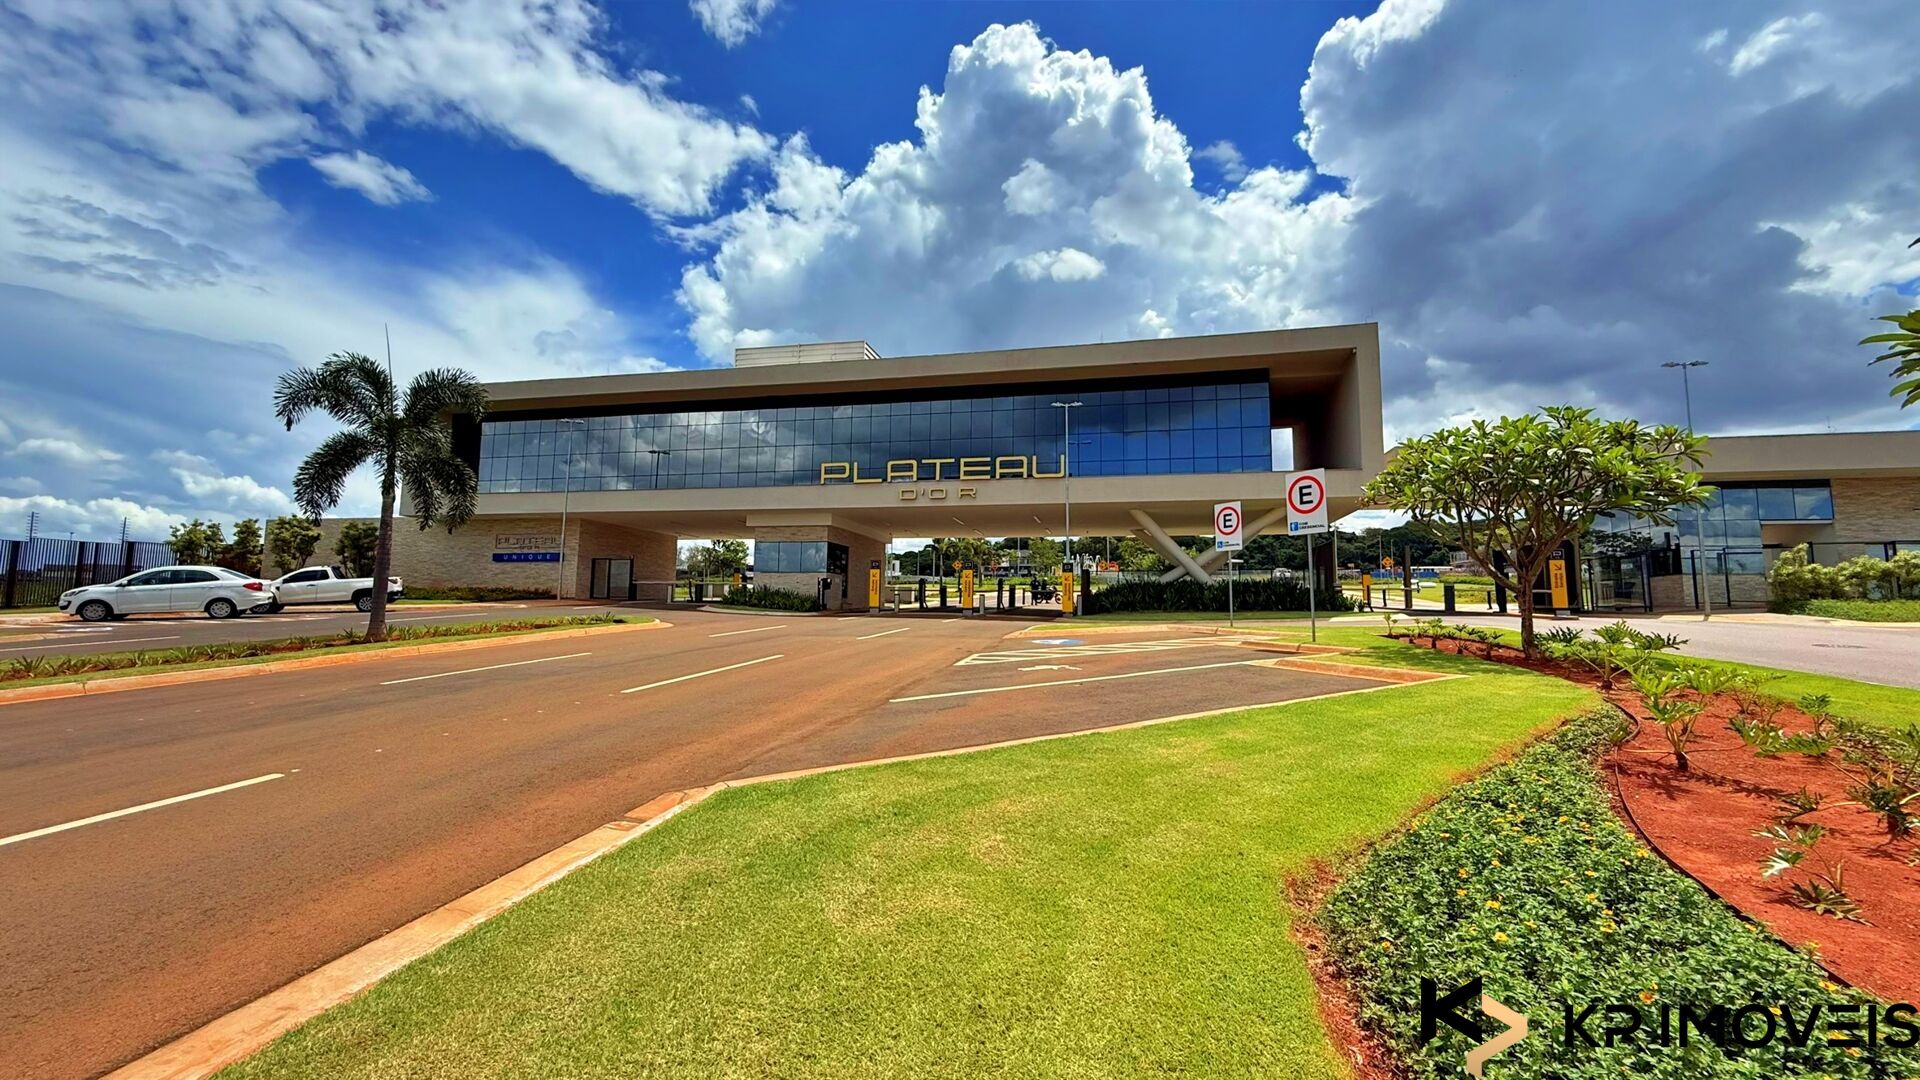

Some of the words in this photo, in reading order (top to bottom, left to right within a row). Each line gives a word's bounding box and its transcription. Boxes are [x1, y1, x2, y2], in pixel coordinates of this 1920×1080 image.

[820, 454, 1065, 485] PLATEAU
[1299, 485, 1313, 505] E
[1223, 513, 1233, 529] E
